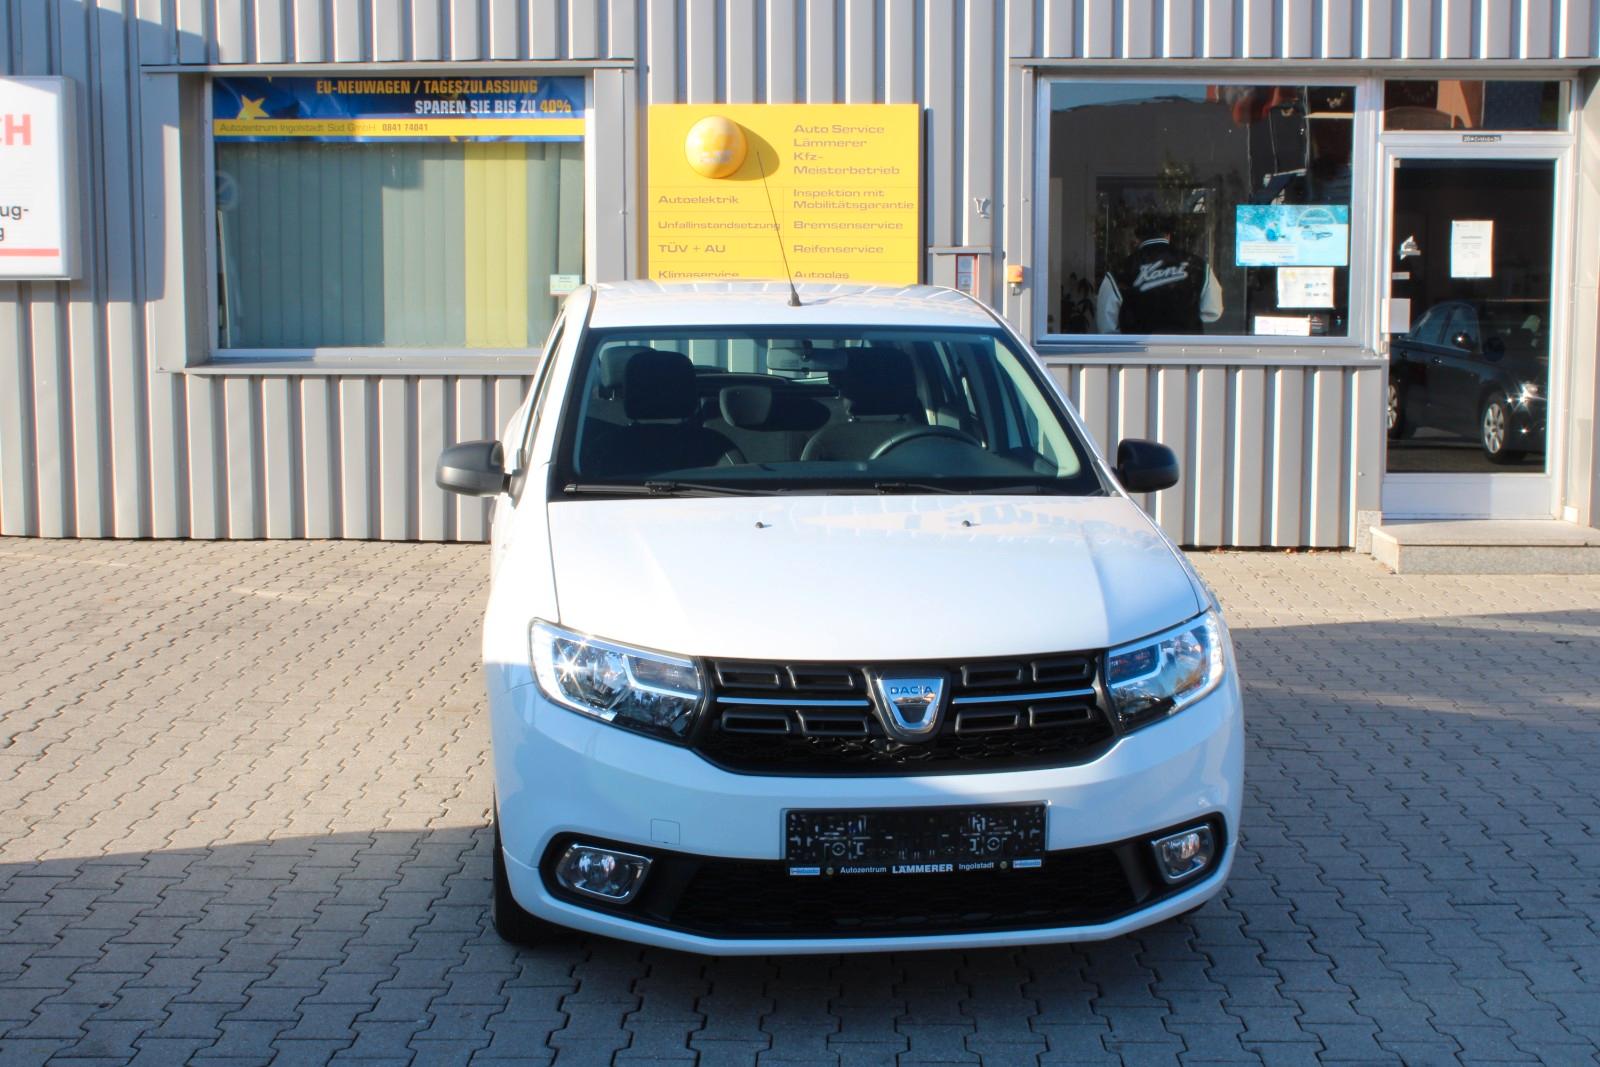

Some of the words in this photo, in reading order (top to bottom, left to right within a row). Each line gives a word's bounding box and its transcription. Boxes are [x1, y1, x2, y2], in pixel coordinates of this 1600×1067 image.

[316, 80, 411, 94] EU-NEUWAGEN
[414, 80, 420, 94] /
[423, 80, 538, 94] TAGESZULASSUNG
[415, 100, 466, 114] SPAREN
[470, 100, 490, 114] SIE
[495, 100, 516, 114] BIS
[520, 100, 536, 114] ZU
[540, 100, 572, 114] 40%
[382, 123, 401, 132] 0841
[405, 123, 428, 132] 74041
[793, 125, 829, 134] Auto
[831, 125, 885, 134] Service
[793, 152, 823, 161] Kfz-
[793, 166, 900, 175] Meisterbetrieb
[793, 189, 861, 199] Inspektion
[863, 189, 885, 197] mit
[658, 195, 739, 204] Autoelektrik
[793, 201, 914, 210] Mobilitätsgarantie
[658, 221, 781, 231] Unfallinstandsetzung
[793, 221, 903, 229] Bremsenservice
[658, 242, 688, 253] TÜV
[704, 244, 726, 253] AU
[793, 244, 884, 253] Reifenservice
[890, 686, 933, 695] DACIA
[840, 866, 887, 874] Autozentrum
[892, 863, 954, 874] LÄMMERER
[958, 862, 995, 870] Ingolstadt
